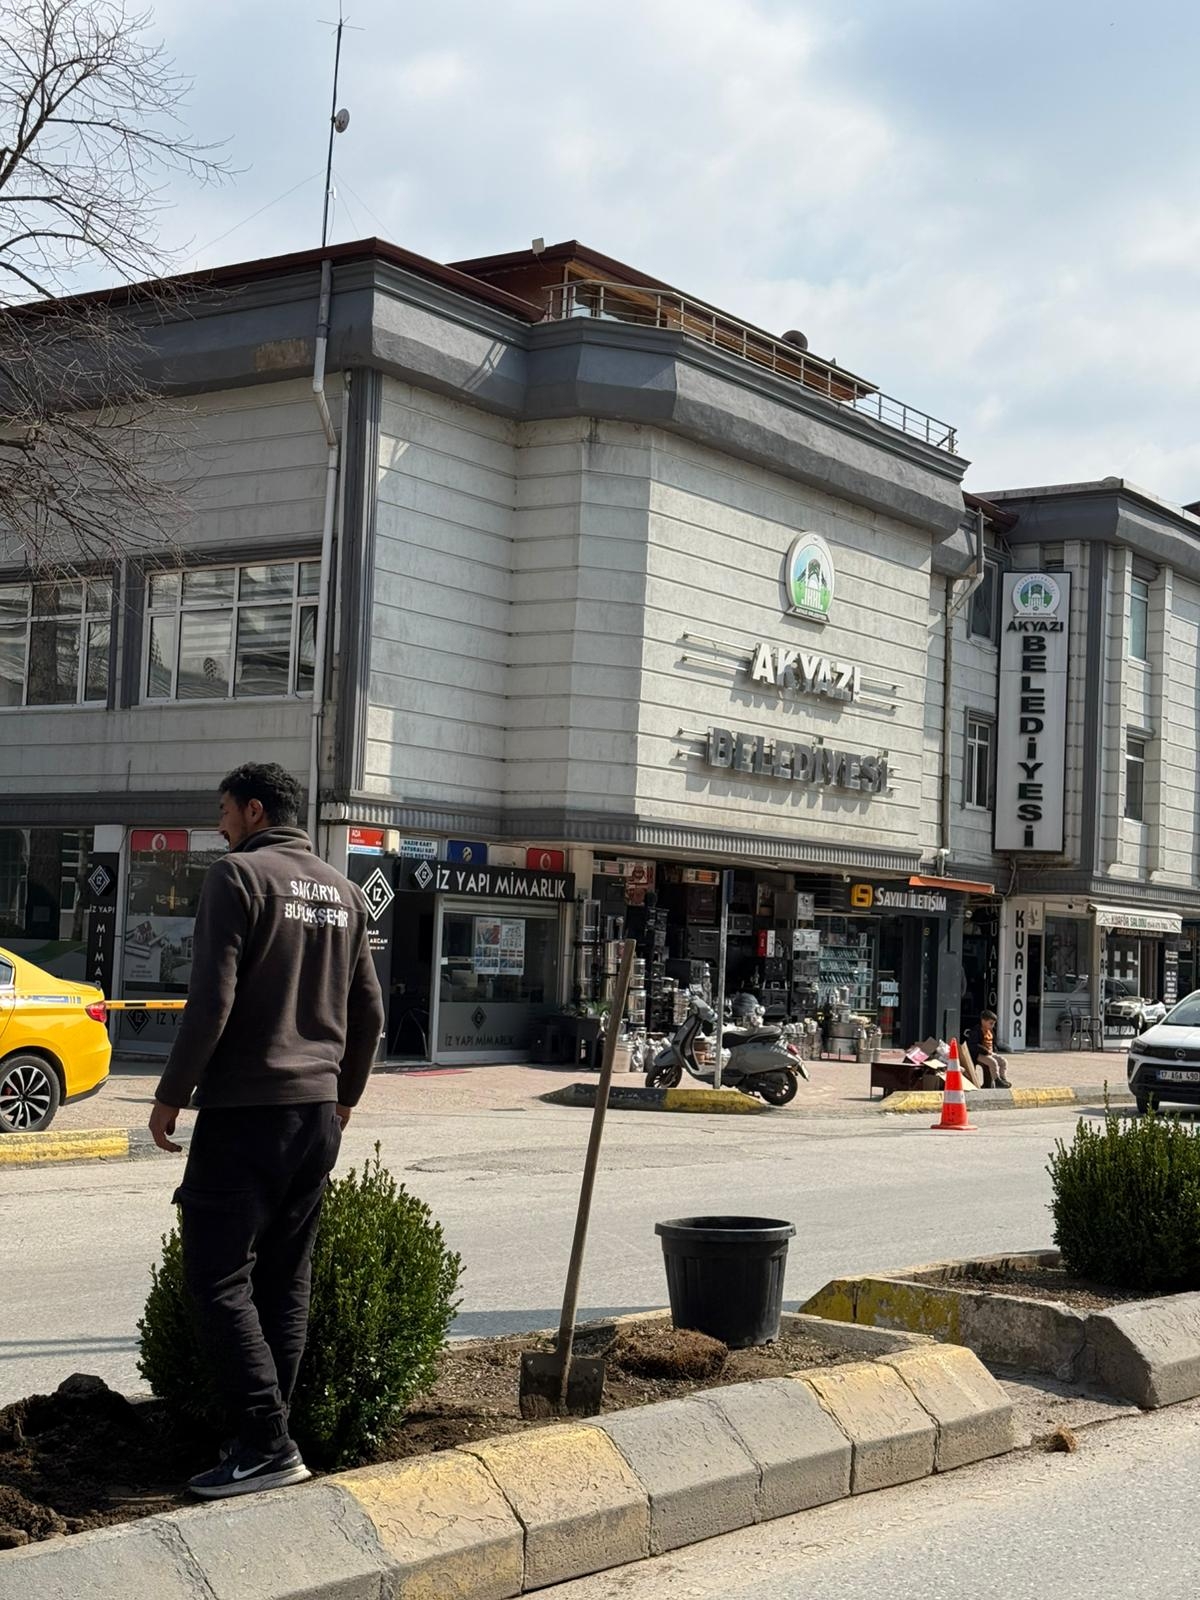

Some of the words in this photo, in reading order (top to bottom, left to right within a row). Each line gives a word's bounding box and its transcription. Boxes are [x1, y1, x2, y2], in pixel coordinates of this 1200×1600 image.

[1006, 620, 1064, 633] AKYAZI
[751, 642, 861, 703] AKYAZI
[706, 725, 888, 794] BELEDİYESİ
[1017, 635, 1047, 848] BELEDİYESİ
[290, 880, 341, 903] SAKARYA
[436, 865, 450, 890] İZ
[456, 870, 490, 894] YAPI
[494, 871, 566, 899] MİMARLIK
[875, 887, 908, 908] SAYILI
[907, 889, 947, 912] İLETİŞİM
[1013, 909, 1025, 1038] KUAFÖR
